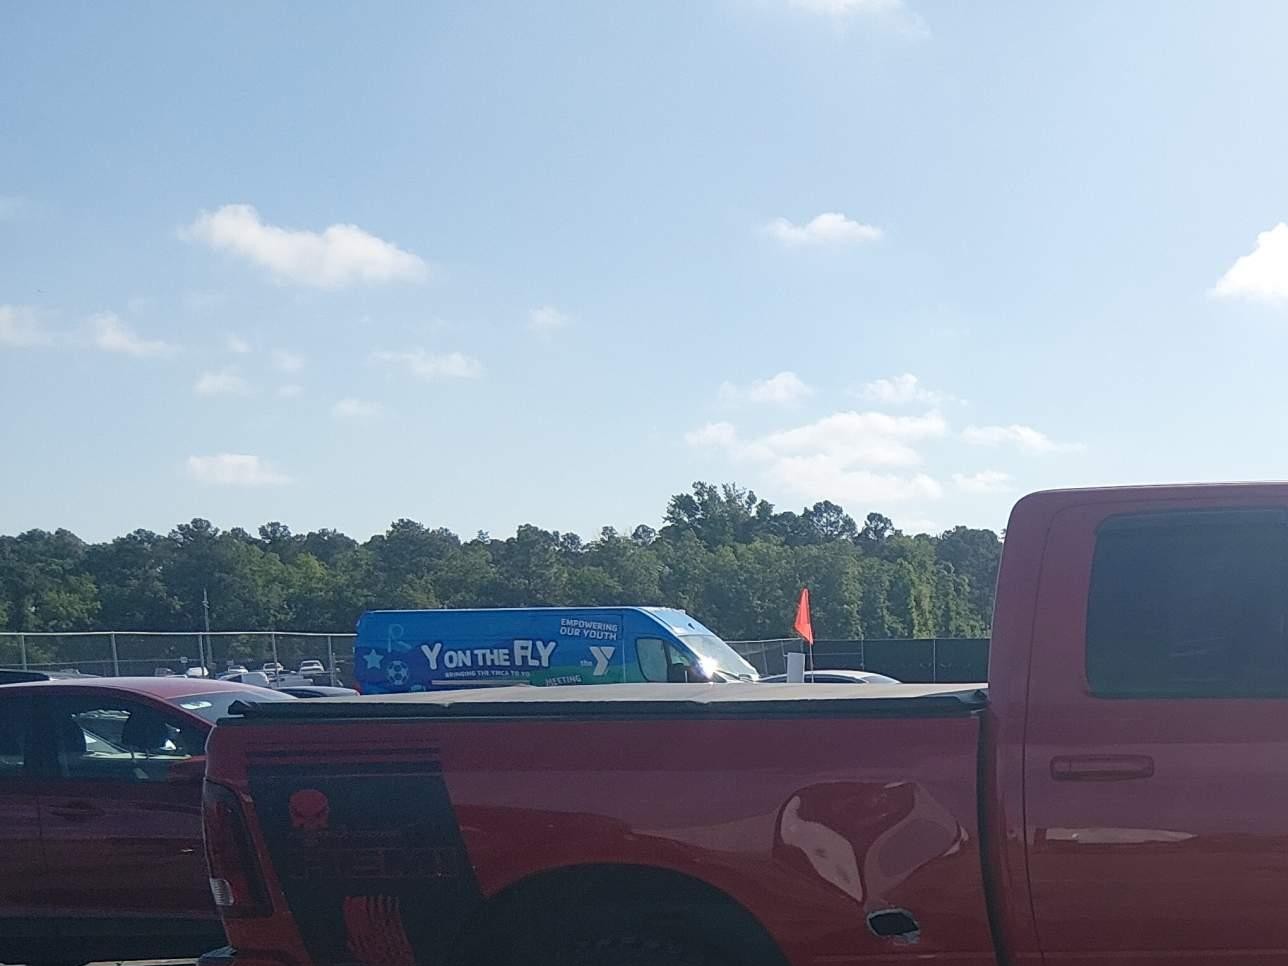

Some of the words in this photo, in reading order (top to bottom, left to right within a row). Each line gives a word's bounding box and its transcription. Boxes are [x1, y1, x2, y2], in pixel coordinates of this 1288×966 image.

[560, 619, 618, 632] EMPOWERING
[560, 626, 580, 636] OUR
[583, 629, 617, 641] YOUTH
[421, 643, 442, 670] Y
[444, 650, 472, 668] ON
[473, 649, 511, 666] THE
[513, 640, 557, 667] FLY
